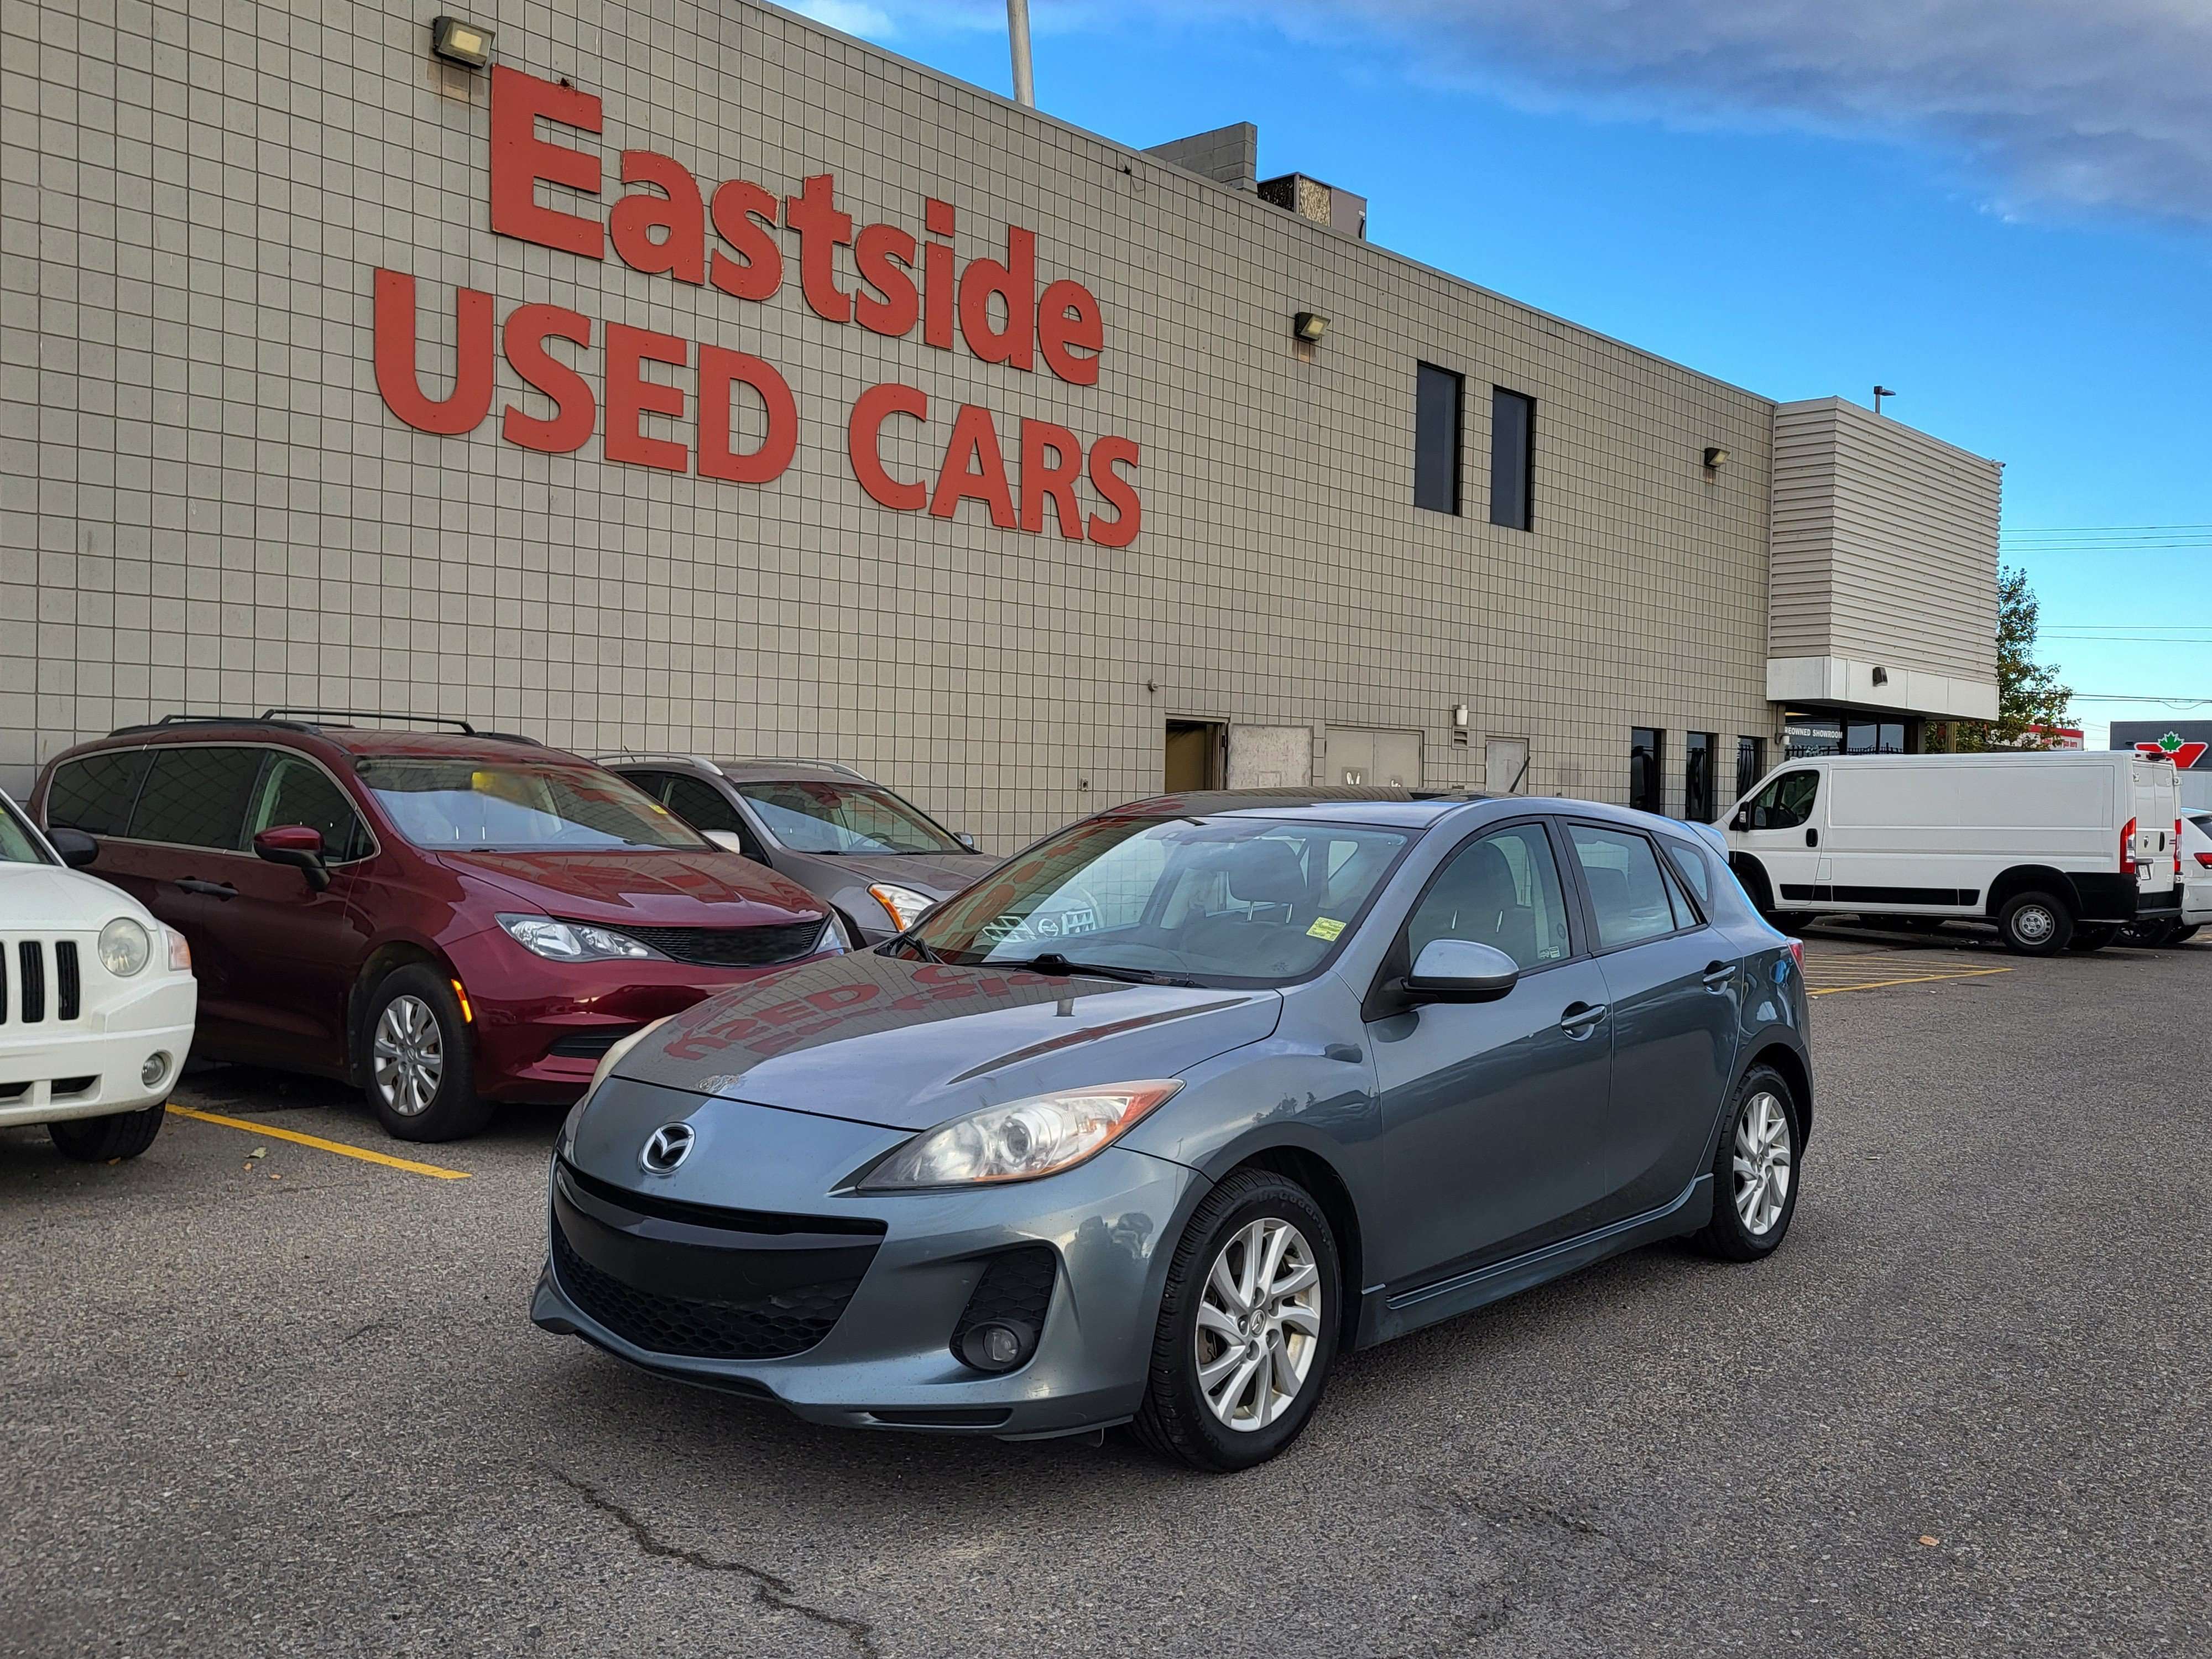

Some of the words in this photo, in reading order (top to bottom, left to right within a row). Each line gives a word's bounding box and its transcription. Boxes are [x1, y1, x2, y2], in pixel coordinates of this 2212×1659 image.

[491, 65, 1104, 385] Eastside
[374, 268, 797, 483] USED
[849, 383, 1141, 547] CARS
[1813, 729, 1843, 739] SHOWROOM
